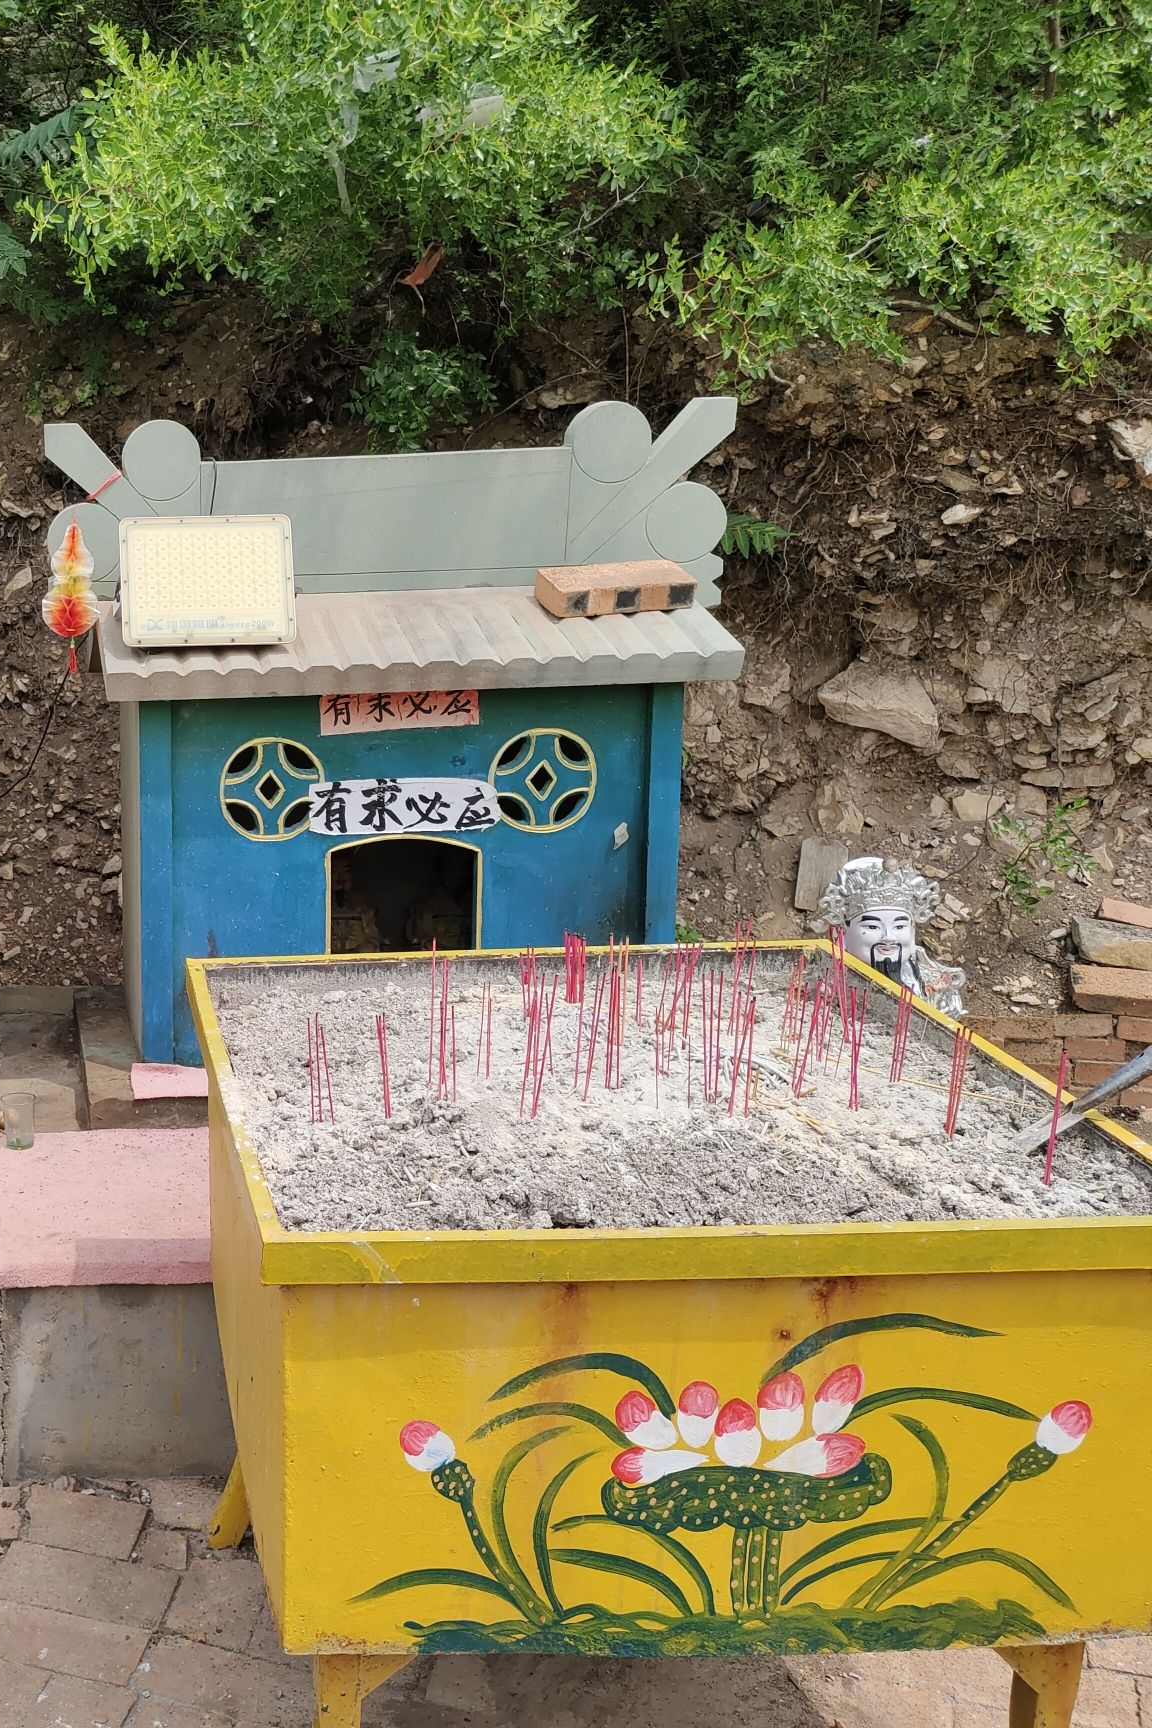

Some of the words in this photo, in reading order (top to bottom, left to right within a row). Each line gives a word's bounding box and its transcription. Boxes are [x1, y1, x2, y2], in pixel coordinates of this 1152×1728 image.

[251, 619, 275, 627] 200W
[323, 690, 472, 727] 有求必应
[313, 778, 496, 834] 有求必应
